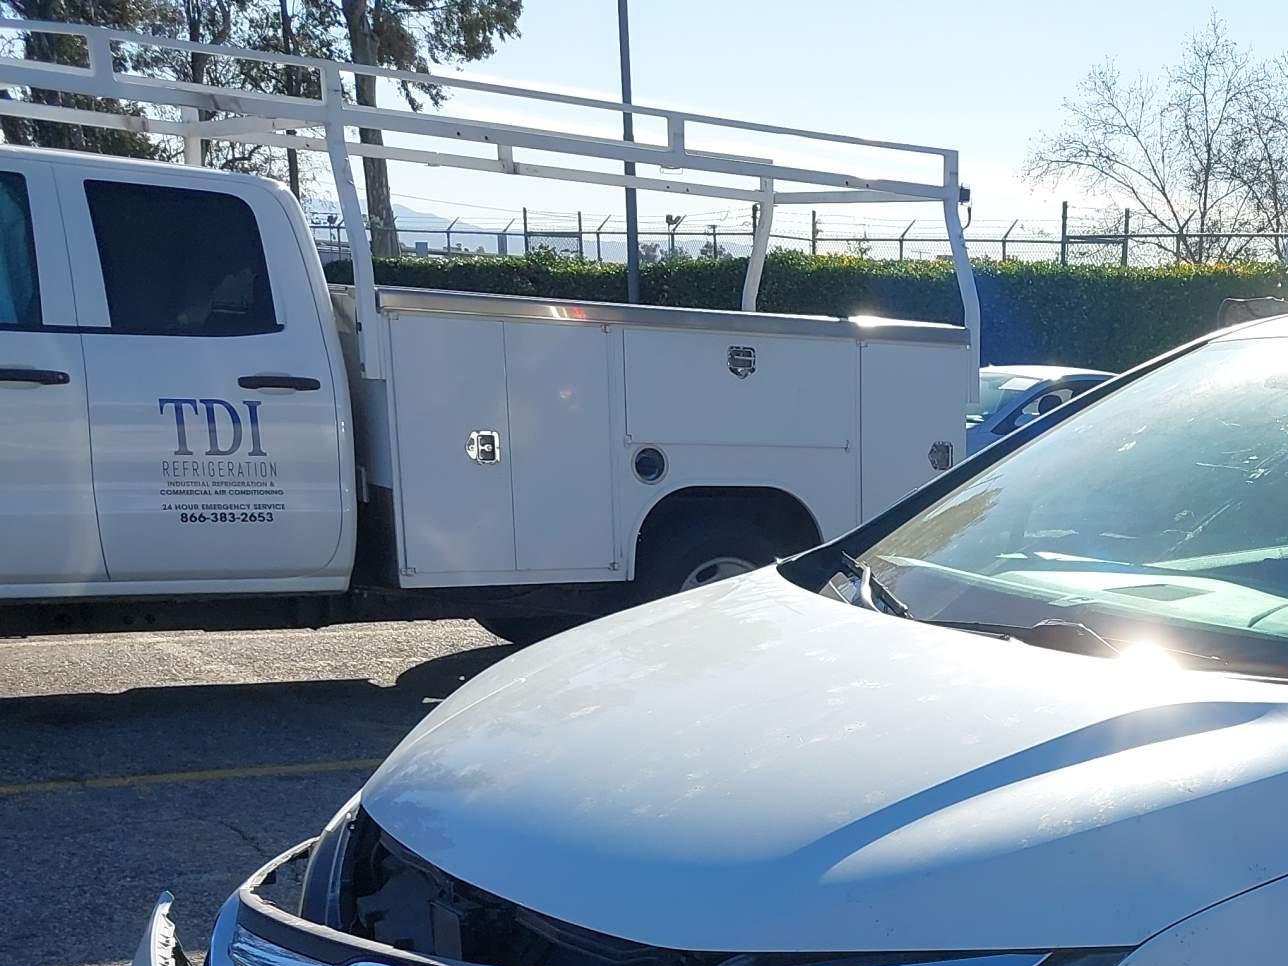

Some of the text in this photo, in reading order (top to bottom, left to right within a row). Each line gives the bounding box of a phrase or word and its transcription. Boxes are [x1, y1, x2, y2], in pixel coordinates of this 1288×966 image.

[158, 398, 268, 457] TDI
[161, 460, 278, 478] REFRIGERATION
[162, 503, 286, 511] 24 HOUR EMERGENCY SERVICE
[180, 512, 274, 523] 866-383-2653
